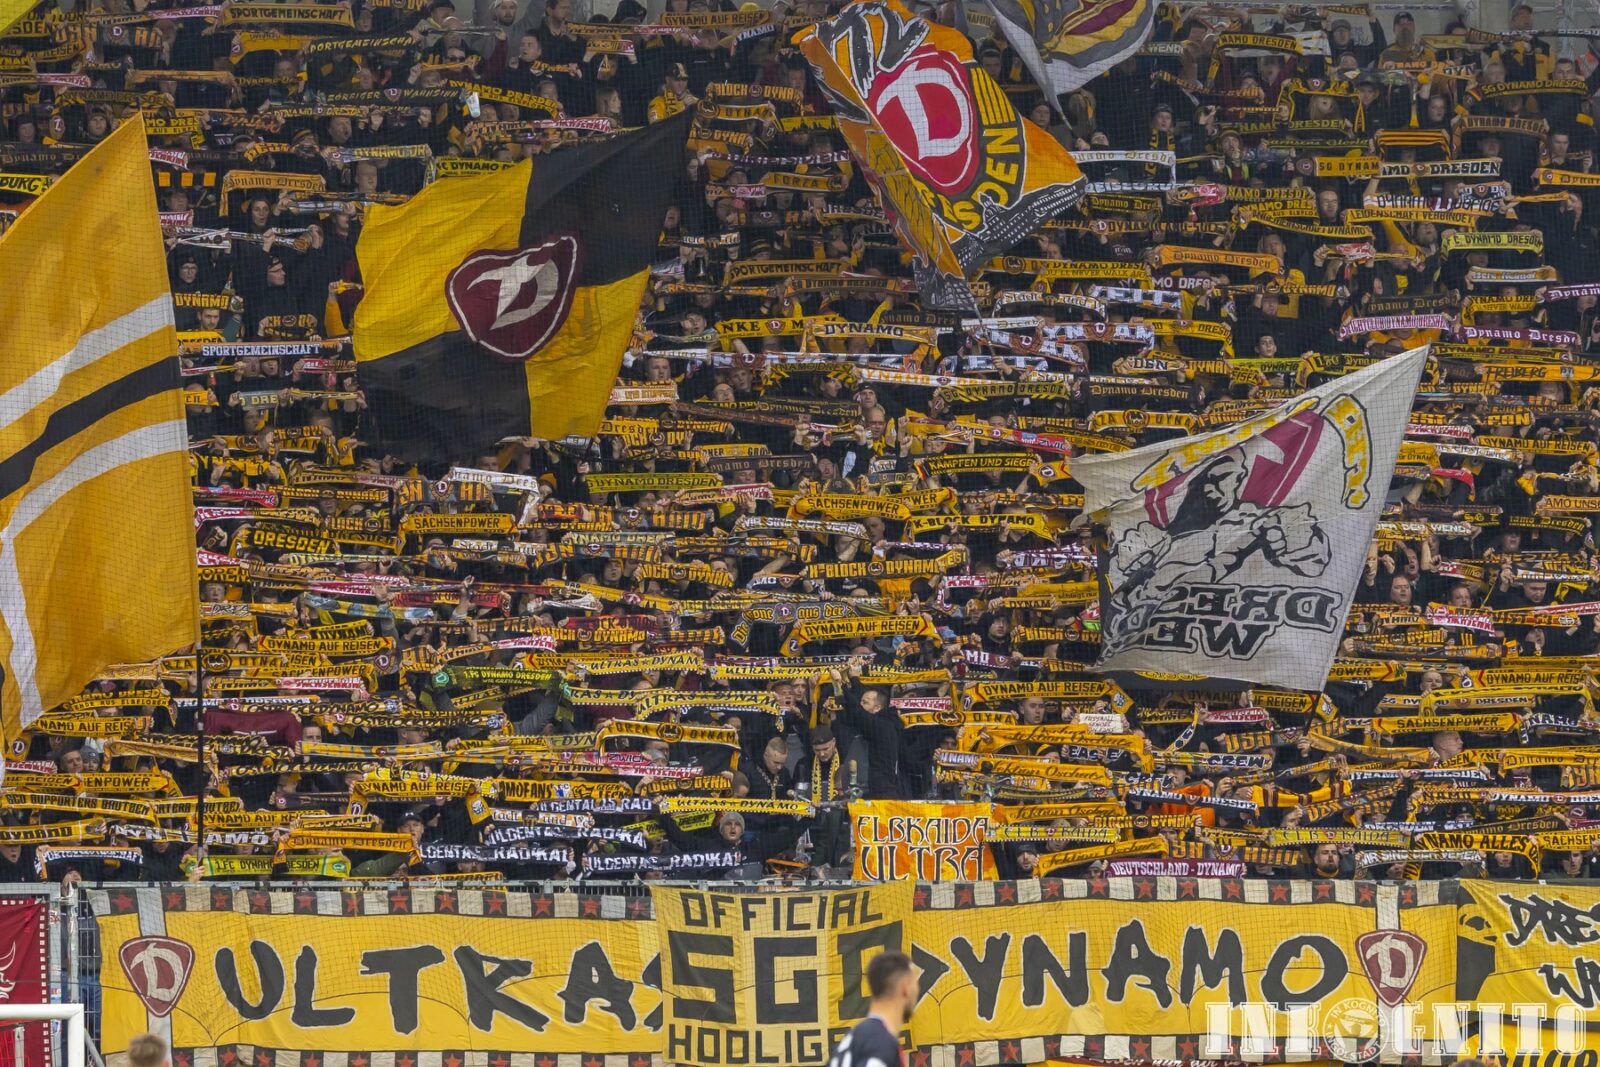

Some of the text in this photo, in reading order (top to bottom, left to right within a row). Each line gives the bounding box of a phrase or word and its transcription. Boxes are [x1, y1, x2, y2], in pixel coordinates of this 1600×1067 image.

[230, 5, 346, 20] SPORTGEMEINSCHAFT
[665, 13, 729, 26] DYNAMO AUF
[450, 79, 502, 96] DYNAMO
[1481, 83, 1497, 94] SG
[1498, 81, 1542, 92] DYNAMO
[451, 162, 499, 172] DYNAMO
[1318, 161, 1334, 171] SG
[1430, 162, 1500, 174] DRESDEN
[773, 173, 820, 189] FORZA
[1350, 209, 1420, 221] LEIDENSCHAFT
[1465, 235, 1502, 245] DYNAMO
[730, 260, 842, 279] SPORTGEMEINSCHAFT
[175, 292, 230, 308] DYNAMO
[824, 322, 904, 337] DYNAMO
[1464, 326, 1521, 340] Dynamo
[202, 343, 321, 356] SPORTGEMEINSCHAFT
[1487, 365, 1547, 379] FREIBERG
[1090, 383, 1189, 399] Dynamo Dresden
[1531, 440, 1554, 450] AUF
[978, 457, 1002, 468] UND
[595, 476, 719, 488] DYNAMO DRESDEN
[808, 497, 901, 516] SACHSENPOWER
[413, 516, 501, 530] SACHSENPOWER
[253, 529, 332, 554] DRESDEN
[804, 617, 921, 636] DYNAMO AUF REISEN
[267, 638, 382, 650] DYNAMO AUF REISEN
[590, 657, 639, 671] ULTRAS
[725, 665, 775, 676] ULTRAS
[481, 671, 514, 680] DYNAMO
[1486, 674, 1533, 686] DYNAMO
[1534, 673, 1556, 684] AUF
[983, 681, 1106, 696] DYNAMO AUF REISEN
[1267, 694, 1309, 710] REISEN
[1475, 695, 1528, 705] DRESDEN
[78, 722, 102, 732] AUF
[607, 720, 651, 735] FORZA
[1396, 717, 1500, 729] SACHSENPOWER
[358, 780, 407, 793] DYNAMO
[410, 780, 432, 792] AUF
[676, 799, 799, 811] ULTRAS DYNAMO
[253, 812, 278, 824] AUF
[857, 814, 991, 845] ELBKAIDA
[1479, 834, 1530, 851] ALLES
[860, 843, 985, 881] ULTRA
[1110, 860, 1190, 877] DEUTSCHLAND
[679, 890, 883, 932] OFFICIAL
[667, 919, 903, 1025] SGD
[668, 1022, 914, 1066] HOOLIG
